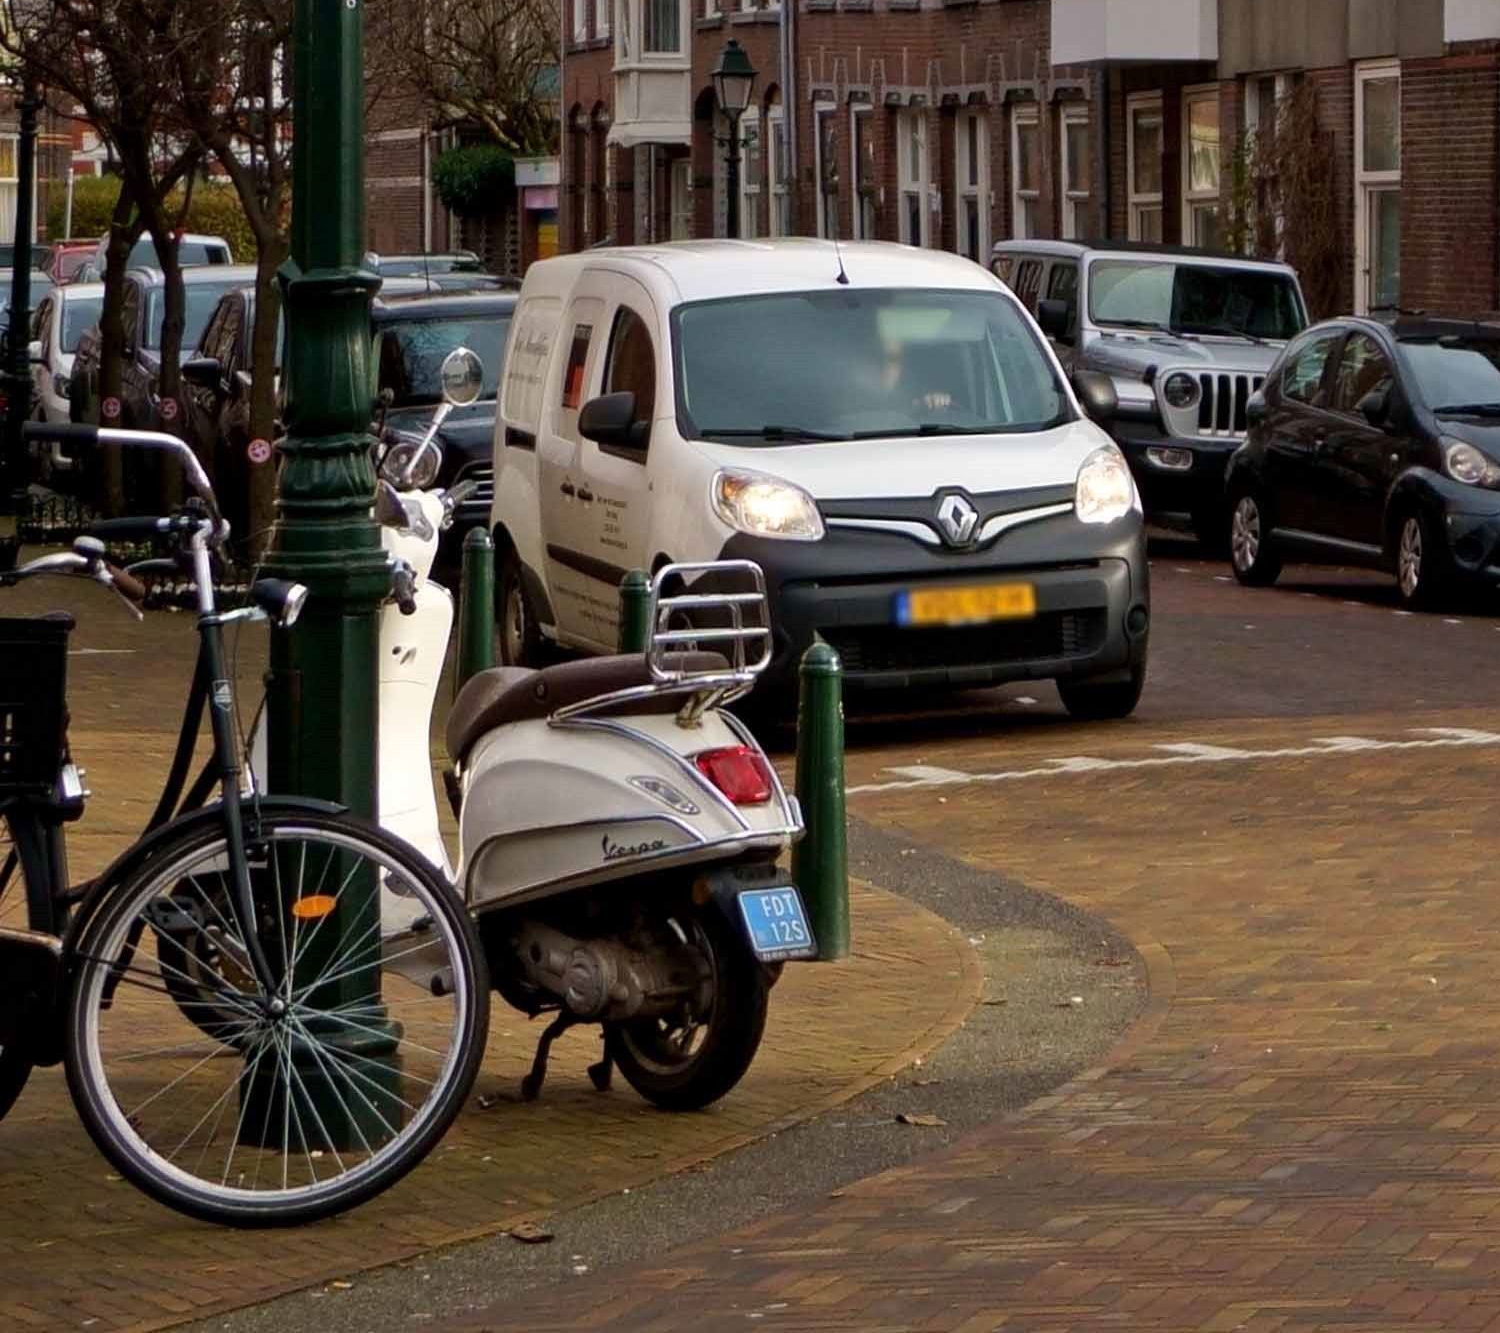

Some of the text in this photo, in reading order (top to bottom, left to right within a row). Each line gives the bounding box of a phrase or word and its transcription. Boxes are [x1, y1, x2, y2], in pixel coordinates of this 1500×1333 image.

[602, 836, 668, 860] Vespa
[760, 894, 796, 918] FDT
[771, 920, 805, 942] 12S
